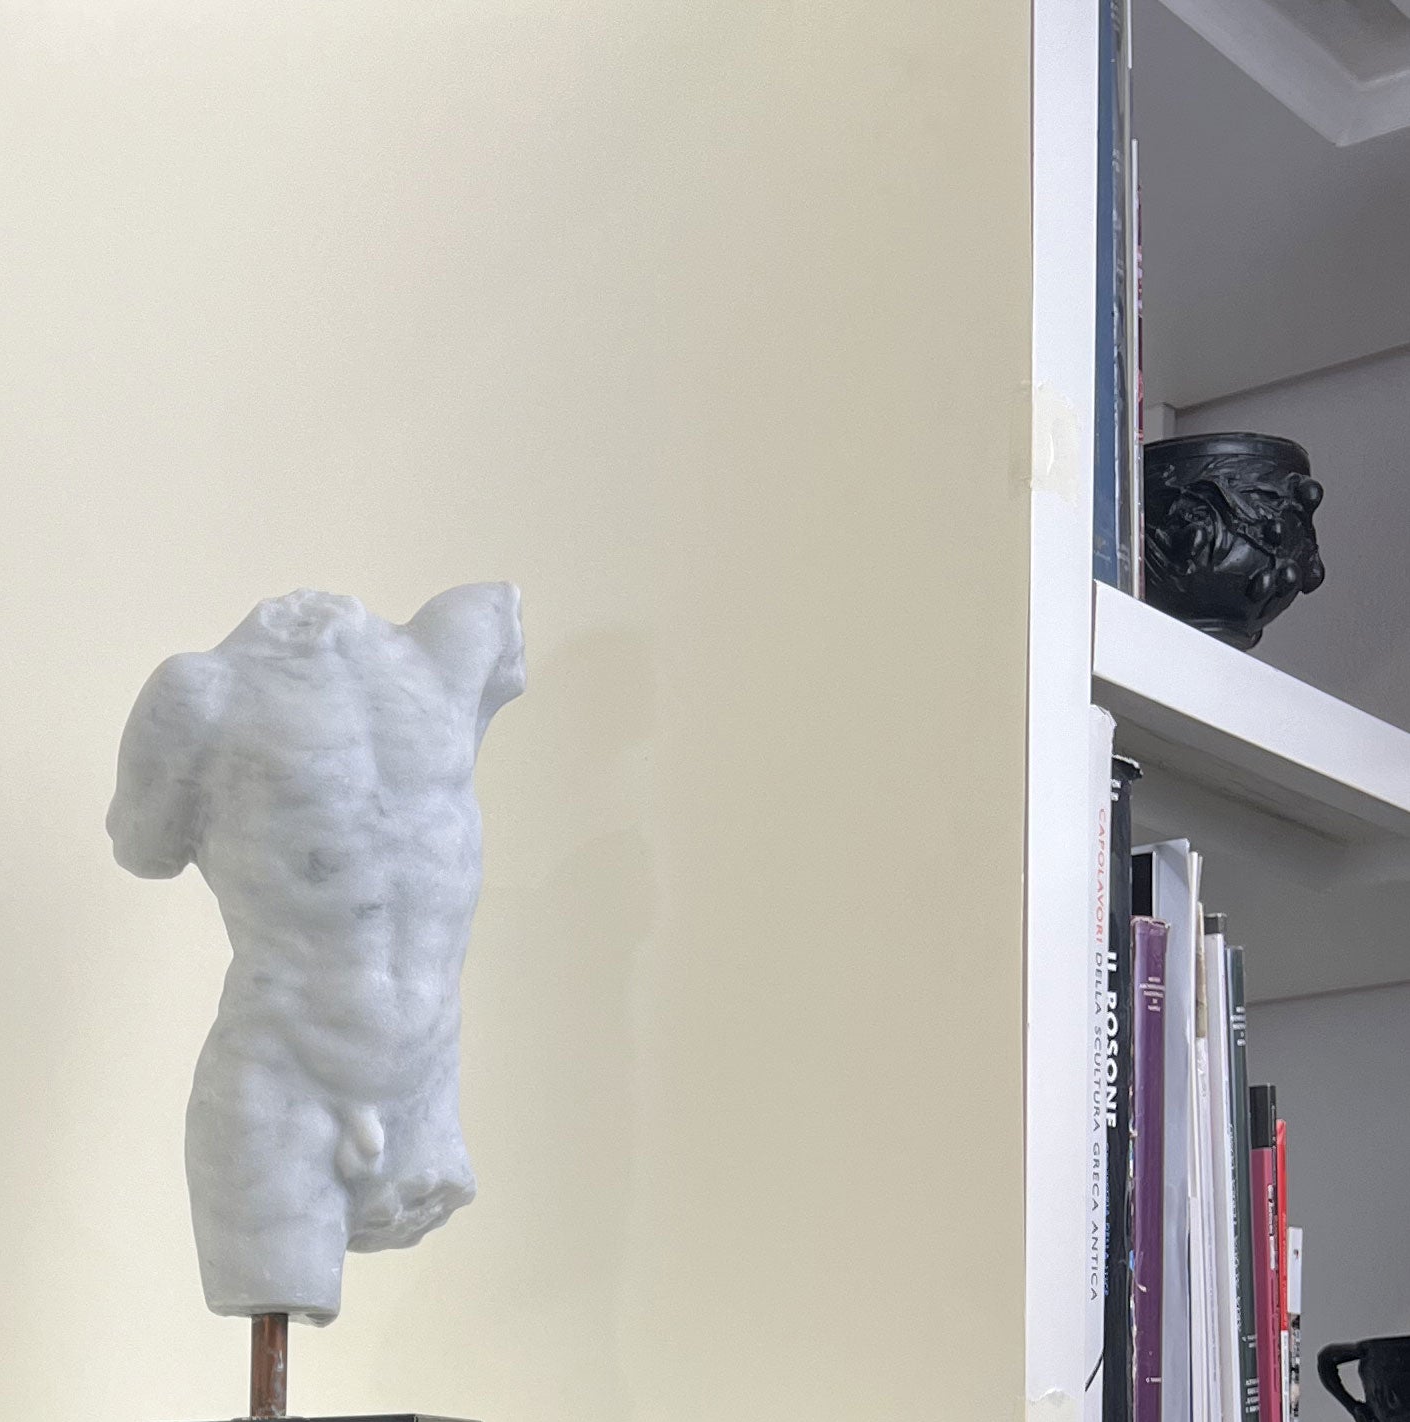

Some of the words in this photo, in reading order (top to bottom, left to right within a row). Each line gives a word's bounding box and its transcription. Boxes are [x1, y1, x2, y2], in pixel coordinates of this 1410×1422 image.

[1095, 808, 1107, 944] CAPOLAVORI
[1094, 952, 1104, 1015] DELLA
[1093, 1026, 1103, 1132] SCULTURA
[1091, 1142, 1101, 1211] GRECA
[1089, 1220, 1100, 1301] ANTICA
